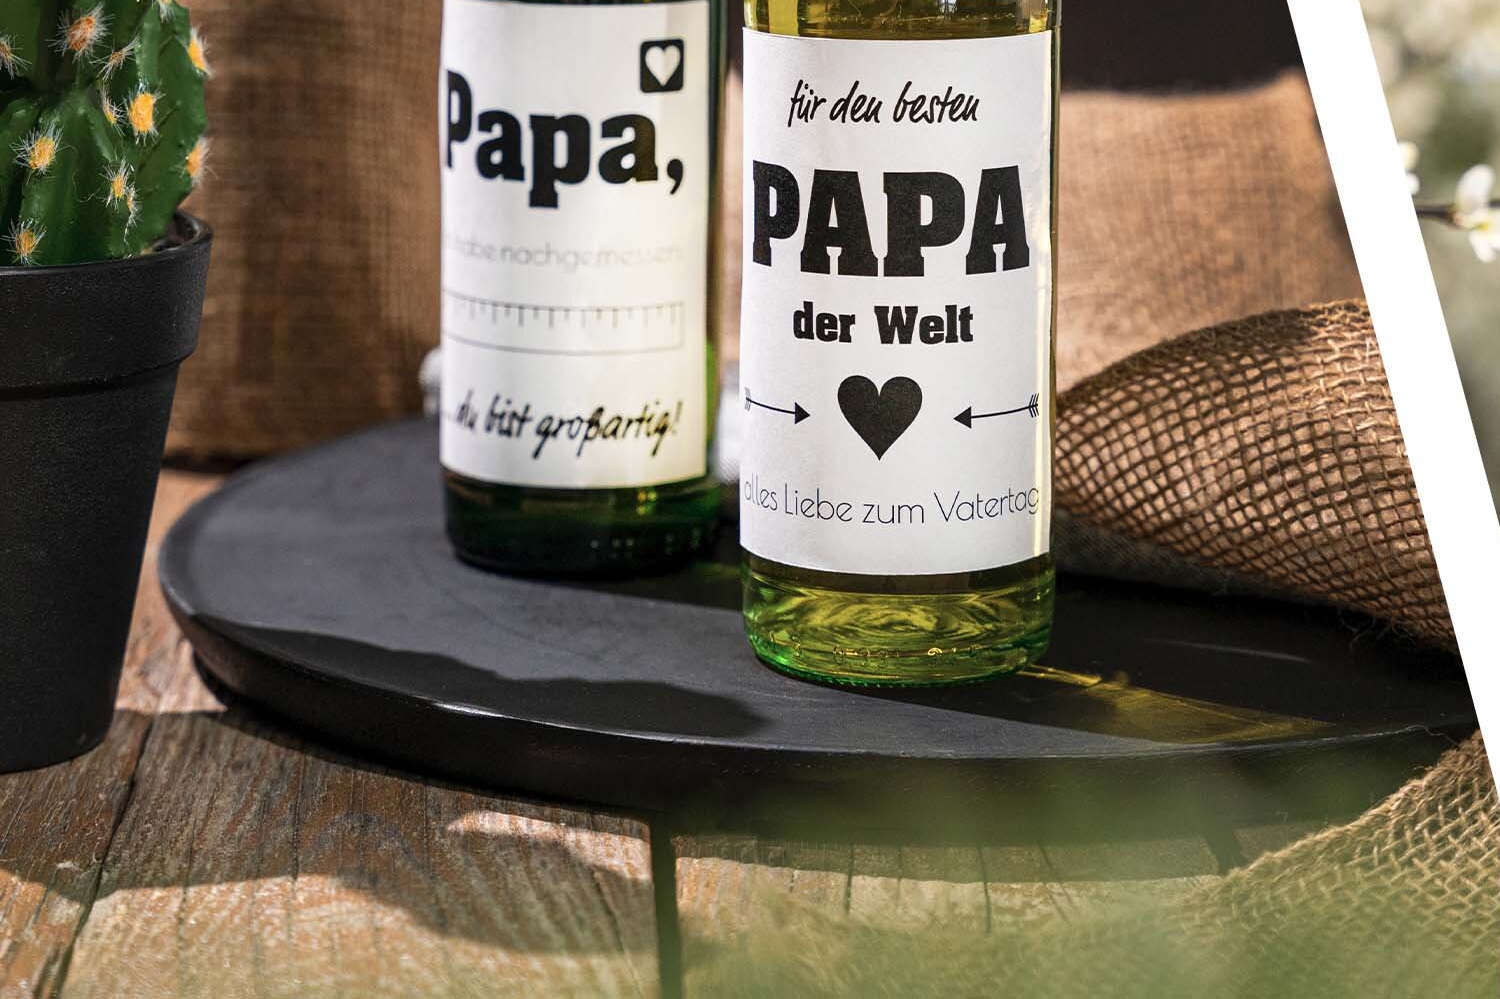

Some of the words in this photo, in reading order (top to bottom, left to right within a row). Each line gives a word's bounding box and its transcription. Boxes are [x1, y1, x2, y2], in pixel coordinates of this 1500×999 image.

[788, 79, 827, 127] für
[830, 80, 881, 125] den
[892, 81, 980, 124] besten
[447, 69, 684, 209] Papa,
[752, 160, 1030, 278] PAPA
[793, 301, 855, 343] der
[873, 304, 974, 345] Welt
[484, 394, 533, 439] bist
[534, 400, 684, 461] großartig!
[744, 473, 778, 512] alles
[784, 483, 853, 522] Liebe
[862, 503, 925, 525] zum
[933, 486, 1040, 522] Vatertag
